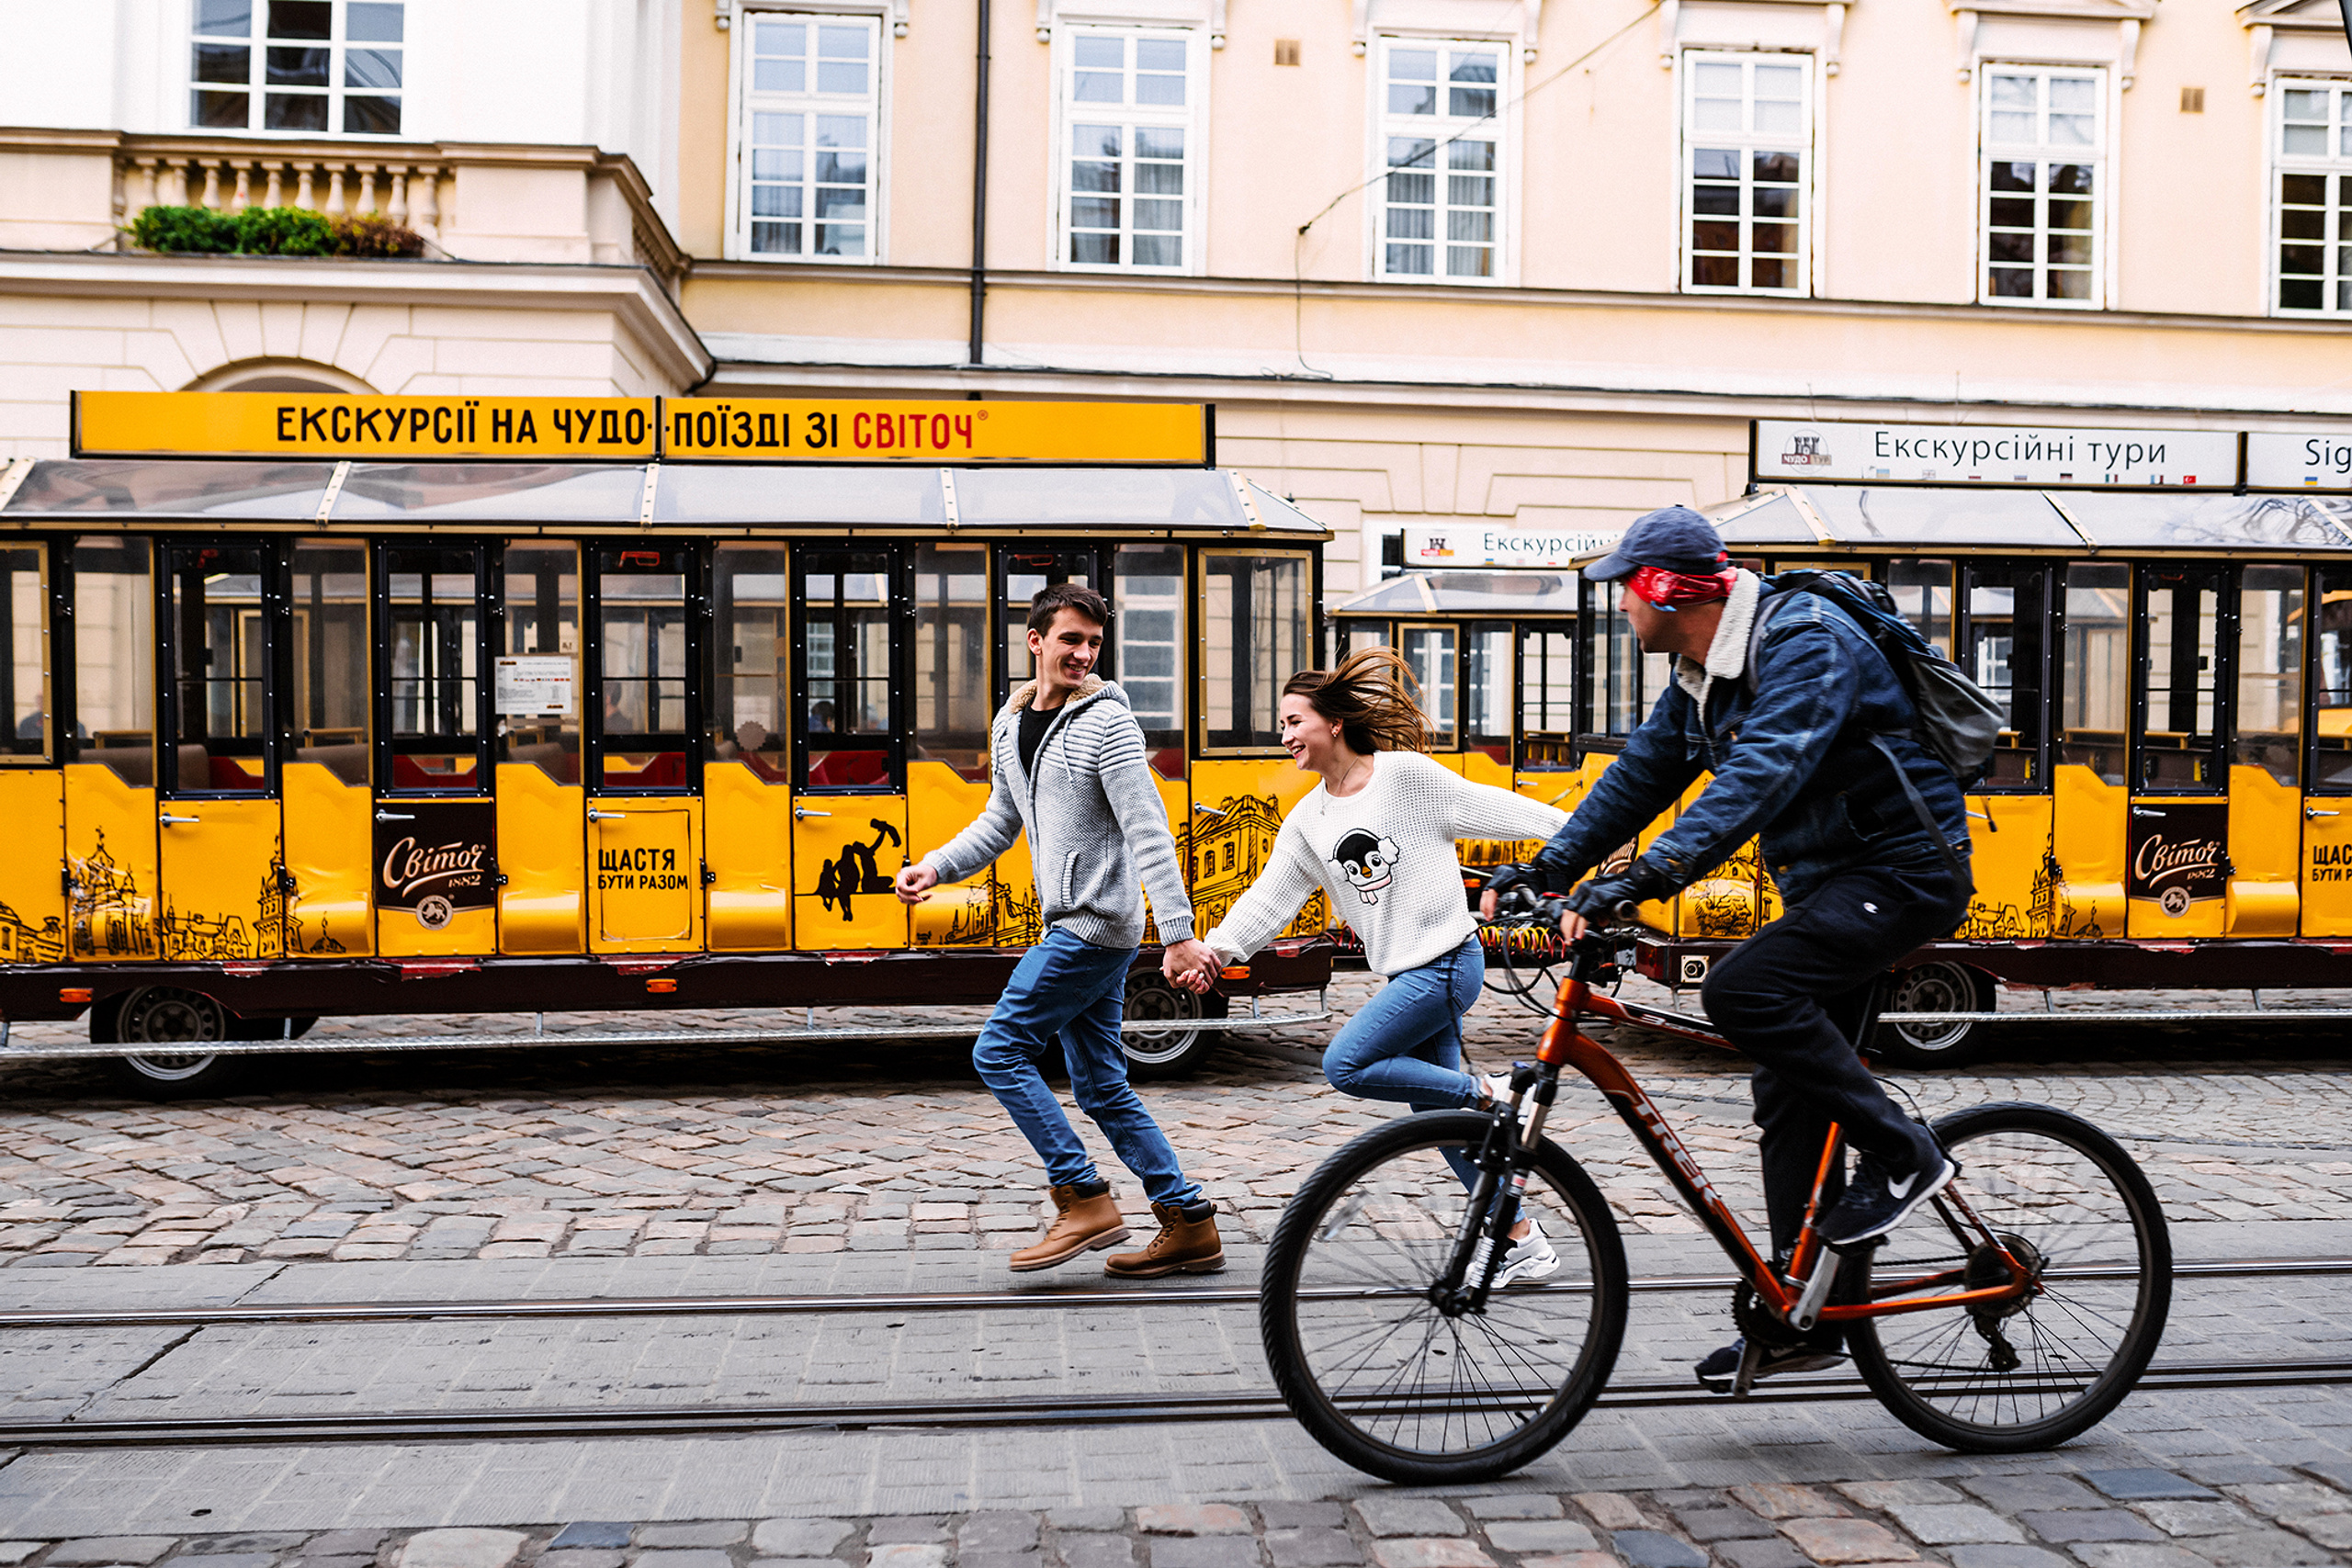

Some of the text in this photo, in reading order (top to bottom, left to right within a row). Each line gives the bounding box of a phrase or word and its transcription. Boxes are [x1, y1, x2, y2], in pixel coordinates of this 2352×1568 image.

[277, 400, 480, 444] ЕКСКУРСІЇ
[492, 408, 537, 445] НА
[805, 412, 838, 448] ЗІ
[1874, 430, 2166, 470] Екскурсійні тури
[2304, 438, 2352, 474] Sig
[1484, 533, 1618, 557] Екскурсій
[598, 848, 675, 873] ЩАСТЯ
[2312, 843, 2352, 866] ЩАС
[448, 874, 481, 888] 1882
[597, 874, 688, 890] БУТИ РАЗОМ
[2312, 868, 2342, 882] БУТИ
[1634, 1091, 1723, 1207] TREK
